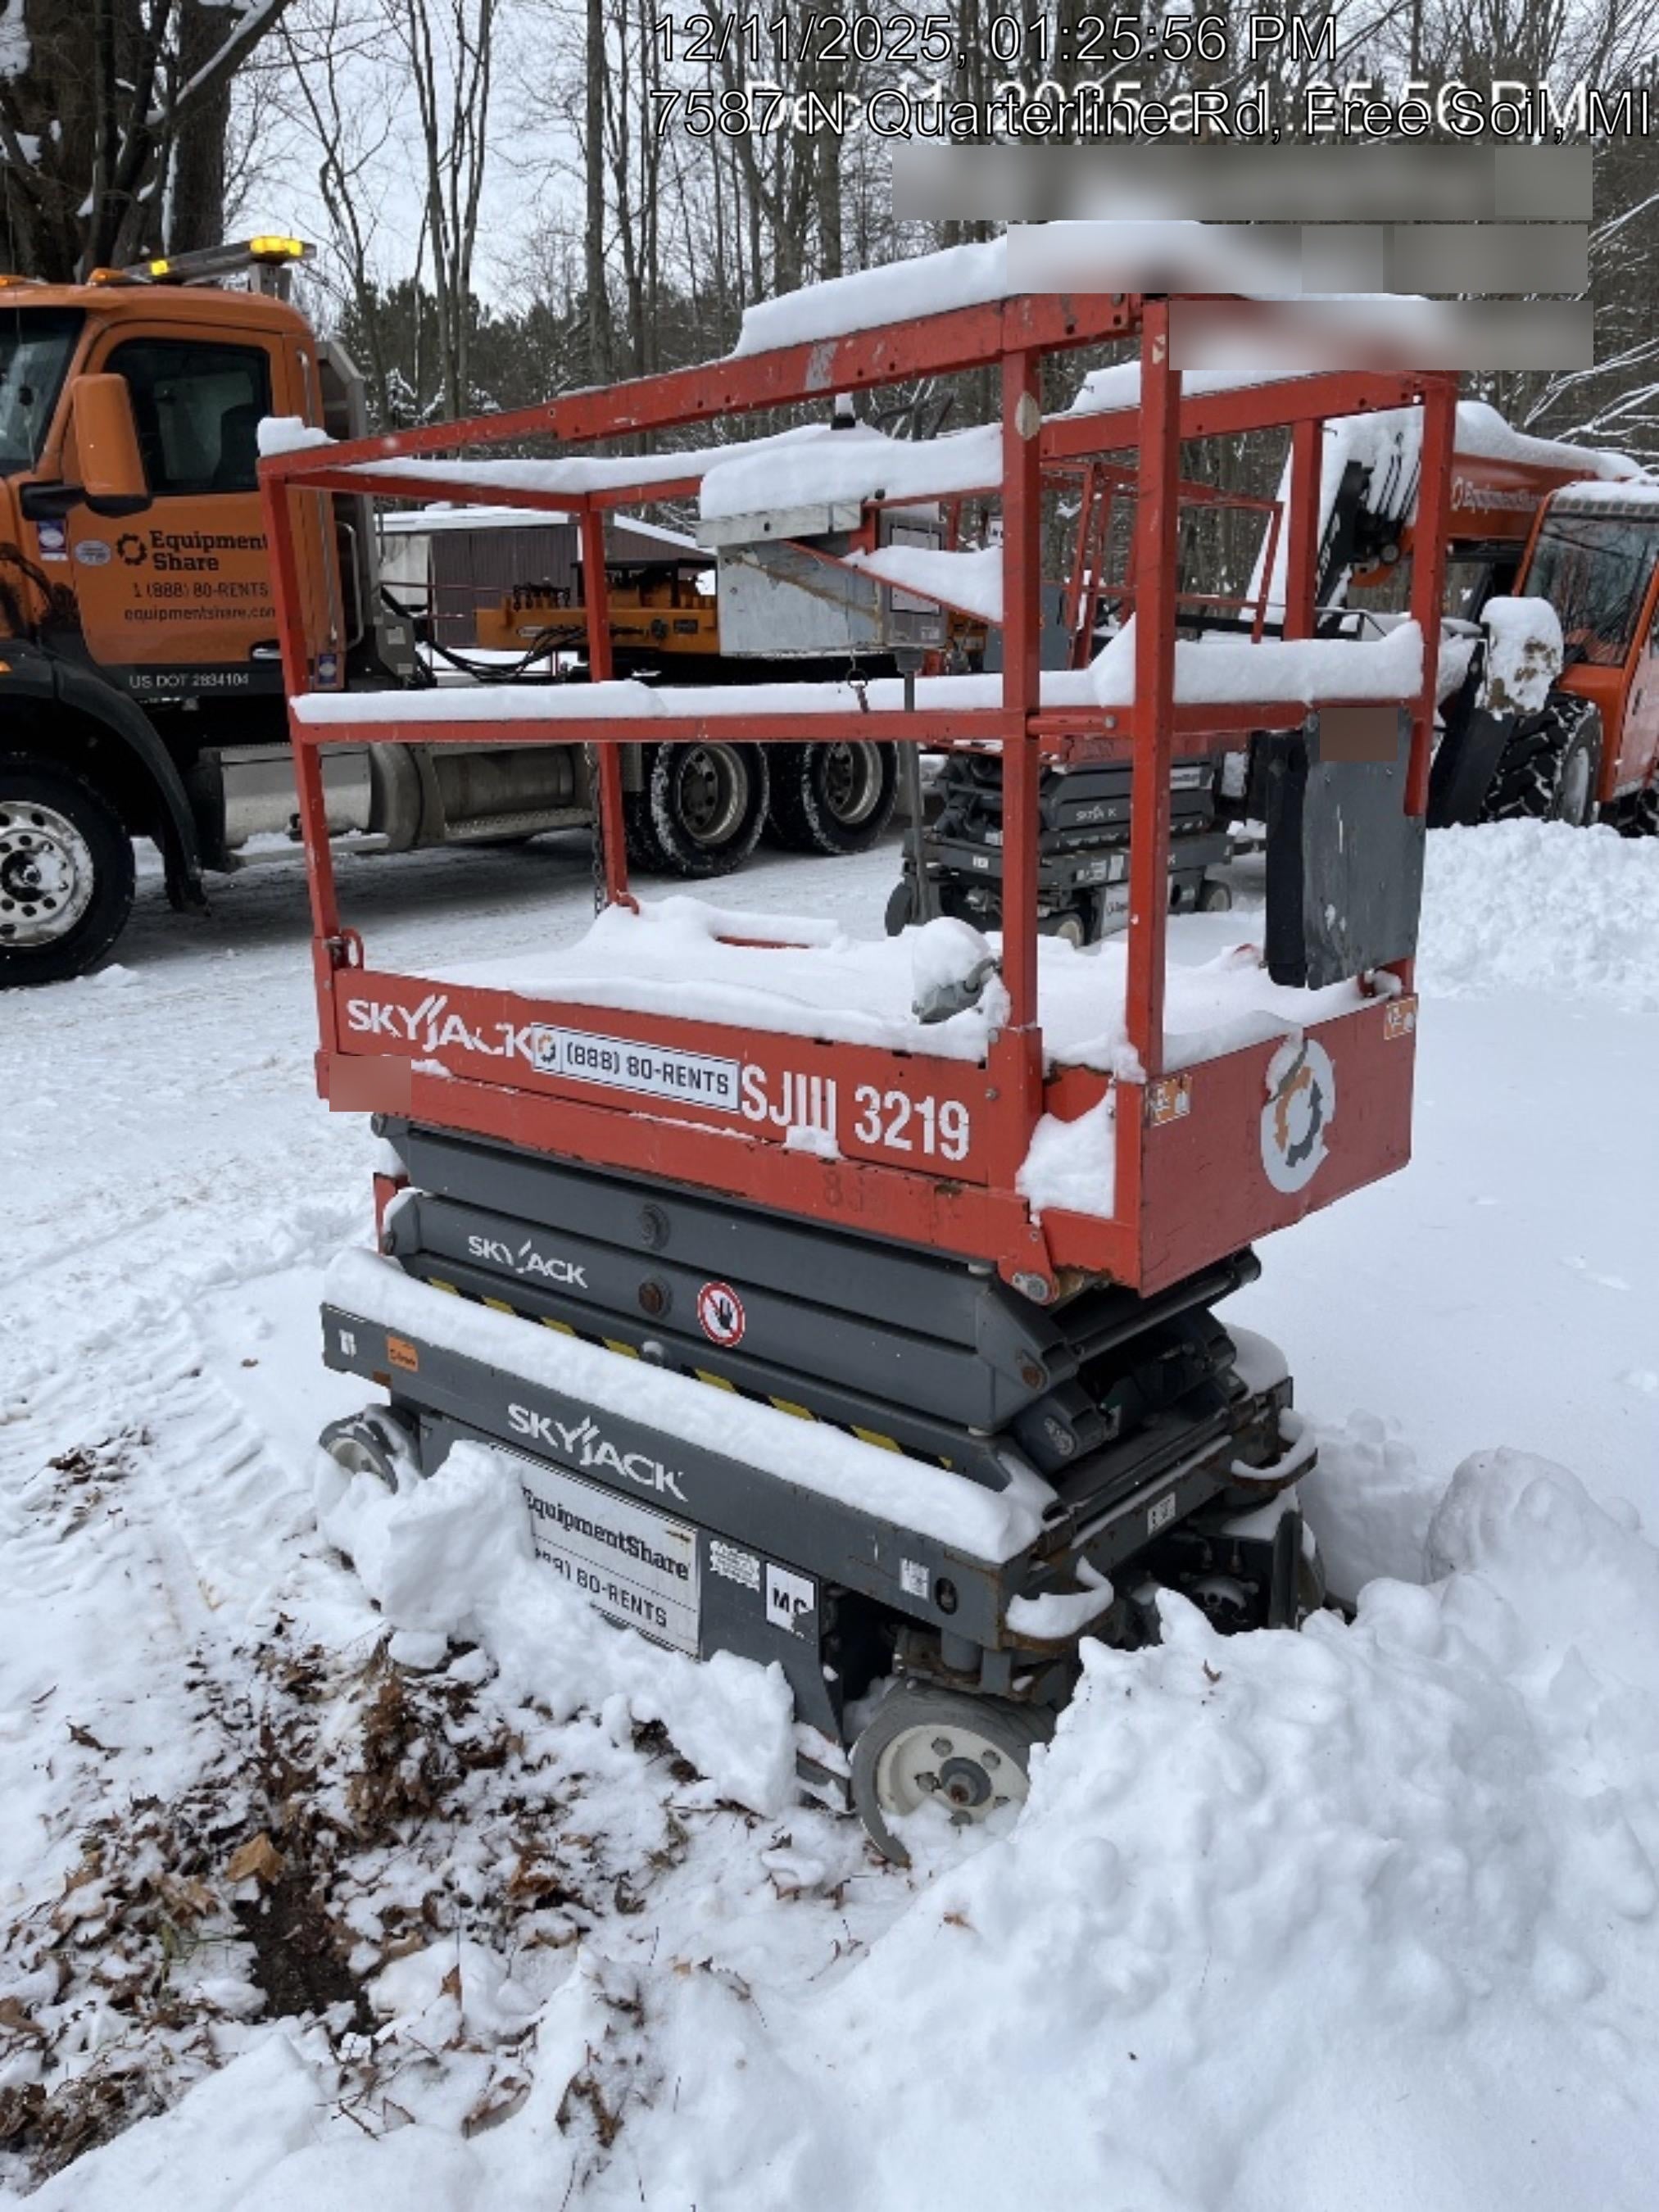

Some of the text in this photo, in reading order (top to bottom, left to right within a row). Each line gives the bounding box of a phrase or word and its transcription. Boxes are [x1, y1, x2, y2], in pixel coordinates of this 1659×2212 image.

[154, 552, 220, 571] Share
[134, 582, 269, 598] 1 (888) 80-RENTS
[129, 674, 152, 687] US
[156, 673, 187, 687] DOT
[567, 1042, 730, 1096] (888) 80-RENTS
[854, 1085, 970, 1162] 3219
[507, 1403, 689, 1503] SKYJACK
[577, 1566, 667, 1628] 80-RENTS
